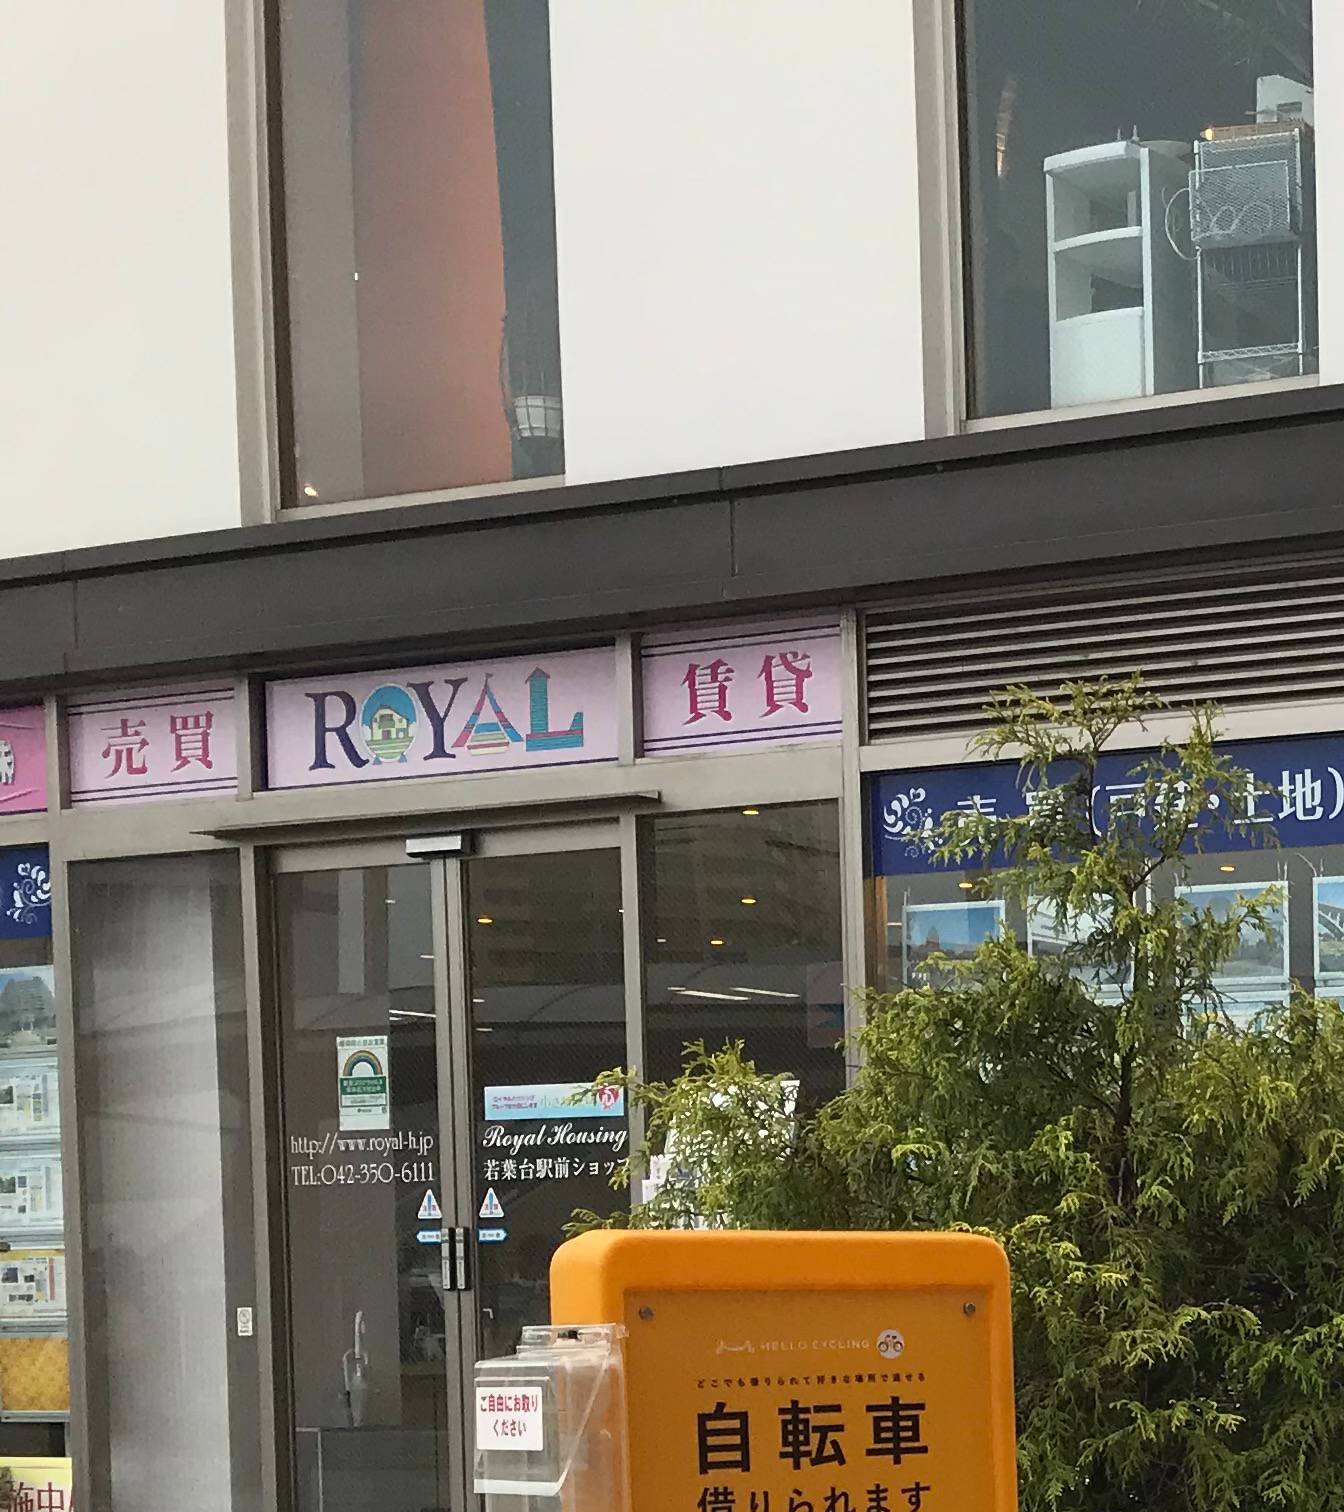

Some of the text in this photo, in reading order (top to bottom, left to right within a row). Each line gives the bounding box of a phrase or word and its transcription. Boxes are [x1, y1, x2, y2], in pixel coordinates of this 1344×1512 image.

[681, 651, 813, 725] 賃貸
[305, 666, 584, 771] ROYAL
[101, 710, 214, 779] 売買
[291, 1131, 434, 1160] http://www.royal-h.jp
[483, 1122, 627, 1155] Royal Housing
[812, 1339, 870, 1351] CYCLING
[493, 1419, 527, 1437] ください
[697, 1396, 929, 1475] 自転車
